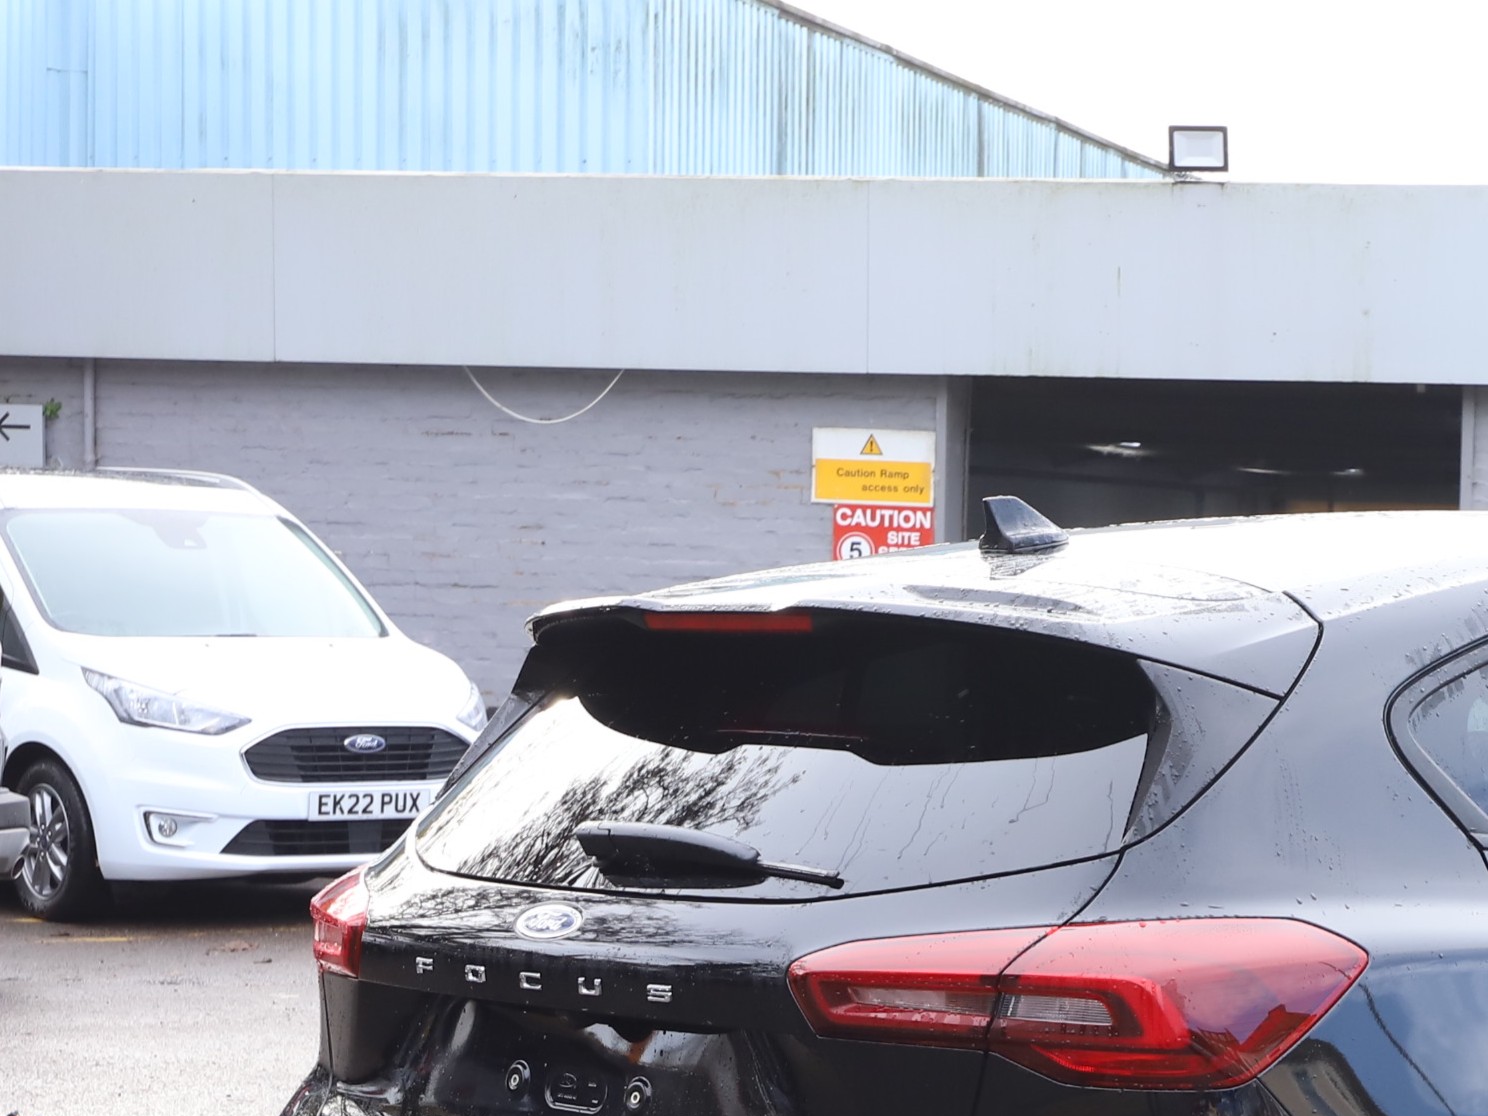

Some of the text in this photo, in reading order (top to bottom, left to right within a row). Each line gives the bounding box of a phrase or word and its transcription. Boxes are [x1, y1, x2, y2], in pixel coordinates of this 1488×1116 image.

[836, 467, 910, 480] Caution Ramp
[861, 484, 925, 495] access only
[835, 507, 931, 529] CAUTION
[887, 531, 920, 545] SITE
[850, 541, 862, 558] 5
[318, 792, 421, 816] EK22 PUX
[415, 956, 673, 1003] FOCUS
